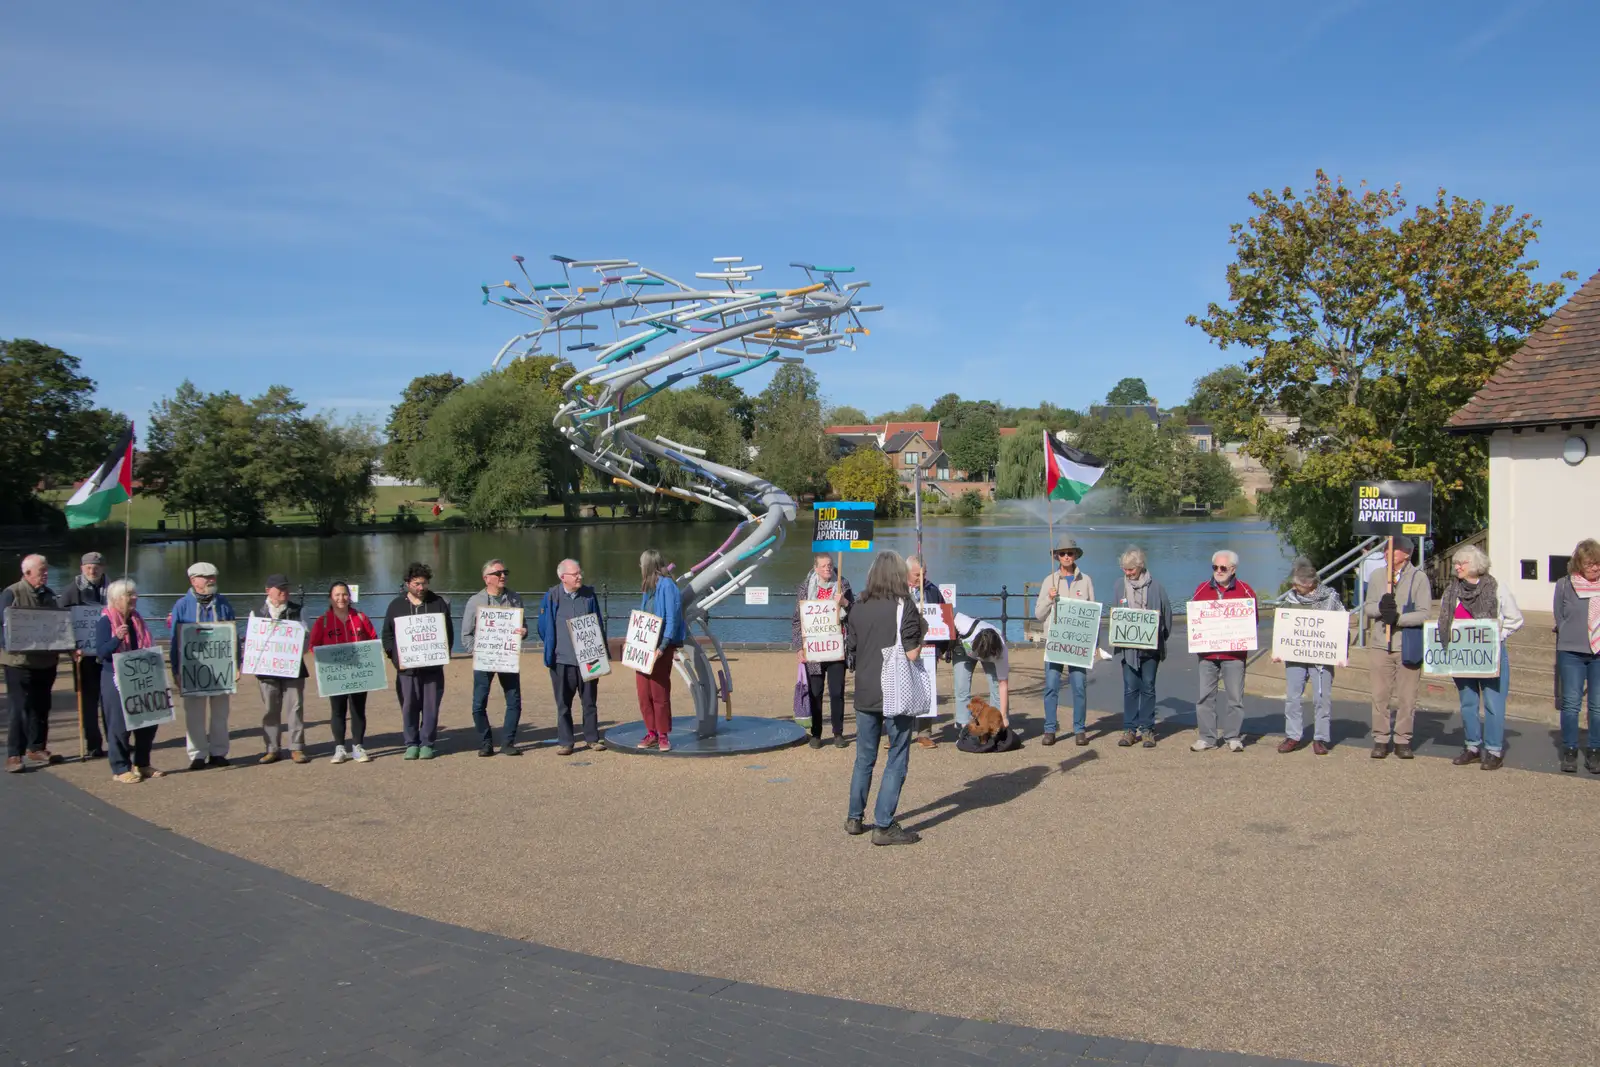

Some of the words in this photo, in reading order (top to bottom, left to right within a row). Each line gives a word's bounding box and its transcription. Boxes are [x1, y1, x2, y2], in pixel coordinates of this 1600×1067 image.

[1359, 486, 1380, 498] END
[1359, 498, 1398, 510] ISRAELI
[818, 507, 838, 520] END
[1358, 510, 1416, 522] APARTHEID
[817, 520, 846, 531] ISRAELI
[816, 530, 859, 541] APARTHEID
[496, 611, 514, 620] THEY
[1068, 605, 1077, 615] IS
[1078, 607, 1099, 618] NOT
[1112, 610, 1157, 624] CEASEFIRE
[570, 616, 598, 632] NEVER
[632, 614, 645, 629] WE
[645, 617, 660, 634] ARE
[812, 616, 831, 625] AID
[1294, 616, 1325, 629] STOP
[251, 622, 302, 638] SUPPORT
[404, 624, 437, 635] GAZANS
[804, 624, 838, 634] WORKERS
[1115, 624, 1157, 643] NOW
[1293, 629, 1326, 639] KILLING
[1434, 628, 1461, 644] ED
[1464, 626, 1492, 644] THE
[411, 632, 437, 643] KILLED
[576, 629, 597, 643] AGAIN
[633, 629, 648, 644] ALL
[1049, 629, 1060, 638] TO
[1061, 630, 1093, 643] OPPOSE
[504, 641, 519, 652] LIE
[583, 639, 595, 647] FOR
[807, 640, 840, 653] KILLED
[1046, 640, 1092, 658] GENOCIDE
[1280, 637, 1337, 650] PALESTINIAN
[184, 640, 232, 661] CEASEFIRE
[579, 643, 605, 660] ANYONE
[625, 644, 650, 667] HUMAN
[1293, 648, 1337, 659] CHILDREN
[1425, 648, 1493, 666] OCCUPATION
[124, 654, 162, 676] STOP
[272, 657, 300, 671] RIGHTS
[403, 654, 420, 664] SINCE
[182, 661, 234, 689] NOW!
[130, 675, 158, 691] THE
